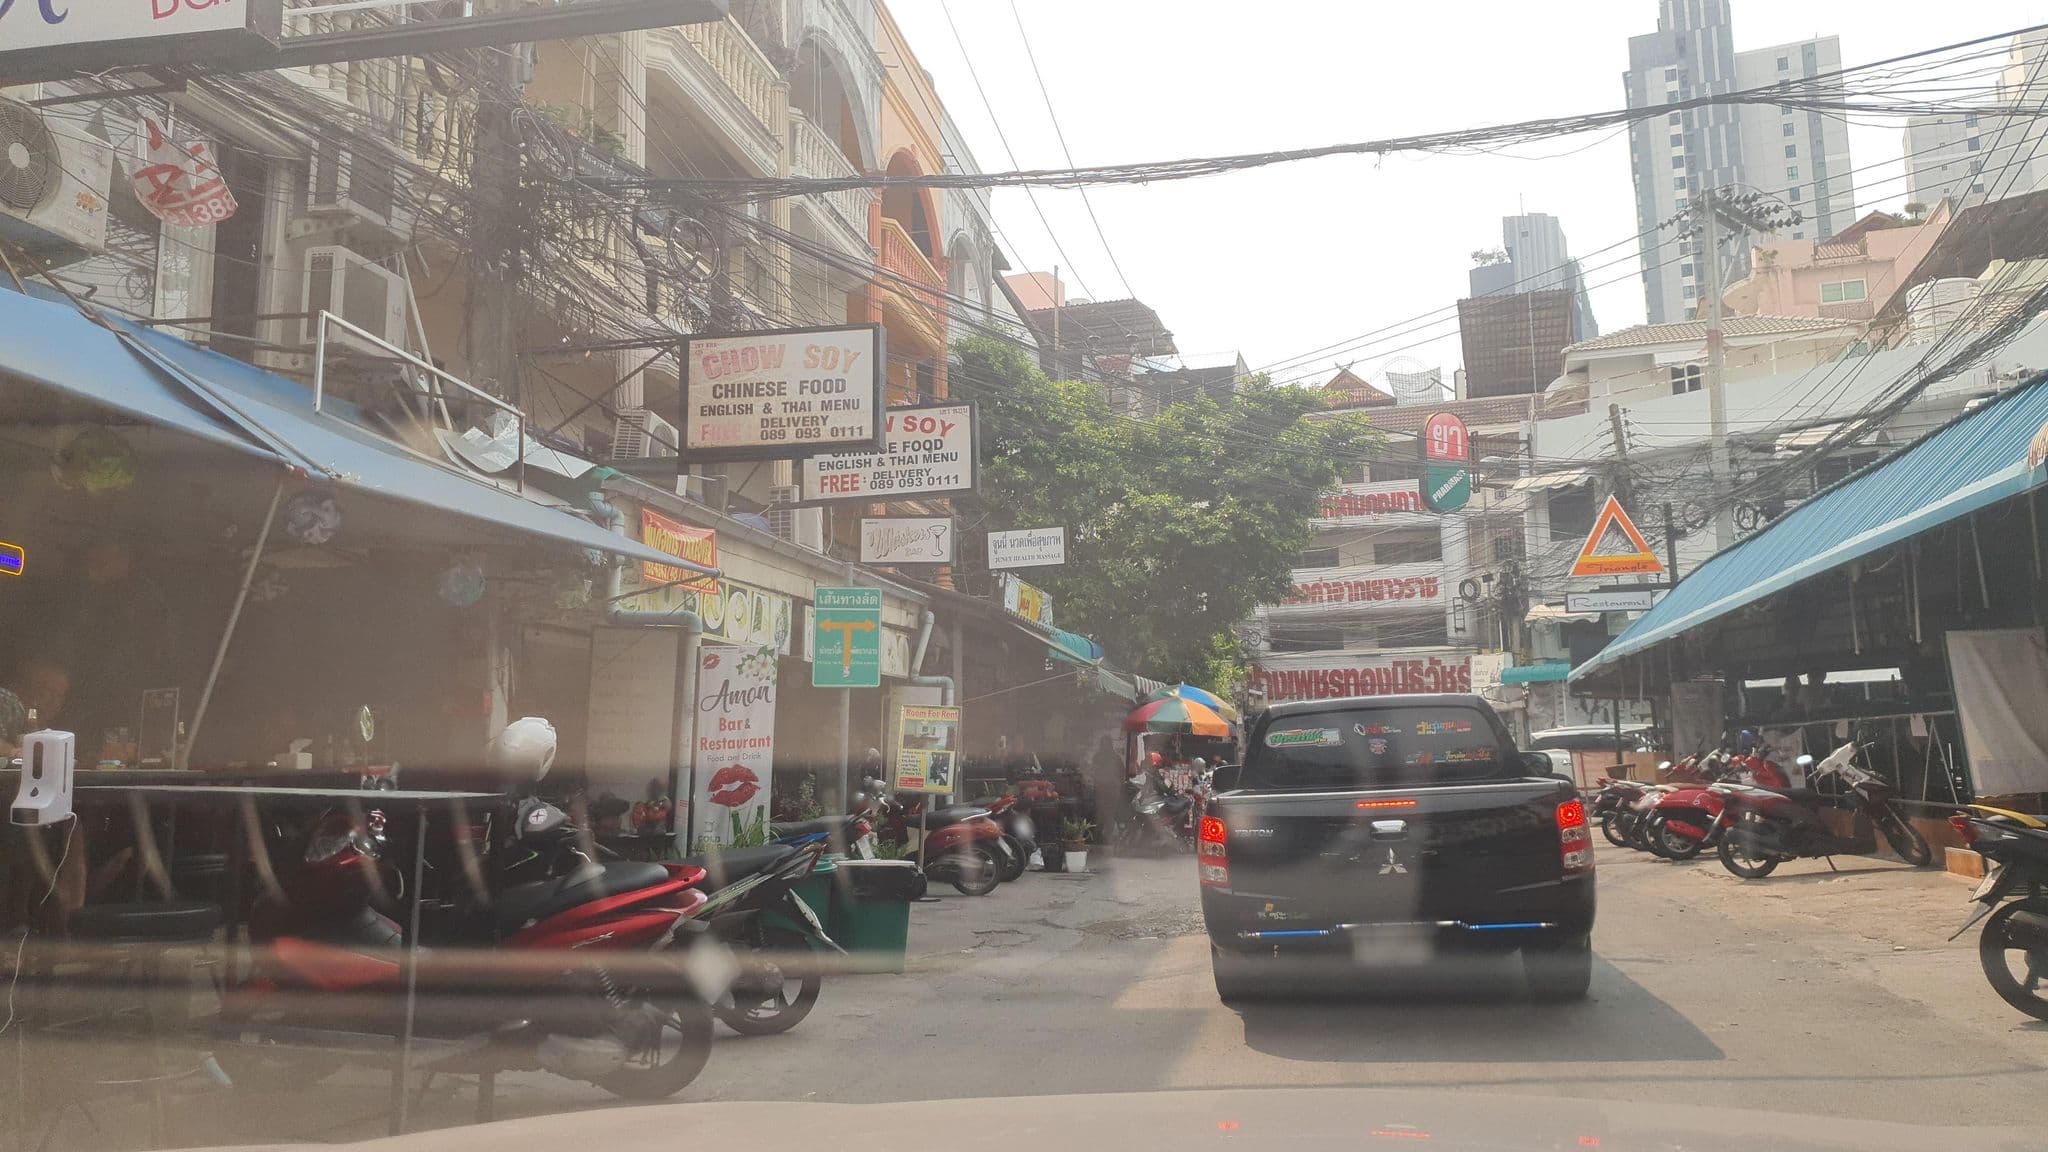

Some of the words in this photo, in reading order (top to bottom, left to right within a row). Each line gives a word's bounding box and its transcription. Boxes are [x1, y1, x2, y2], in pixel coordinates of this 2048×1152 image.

[701, 344, 786, 379] CHOW
[803, 344, 862, 373] SOY
[712, 381, 787, 399] CHINESE
[799, 378, 847, 394] FOOD
[700, 403, 753, 416] ENGLISH
[762, 402, 773, 414] &
[782, 401, 811, 413] THAI
[821, 398, 860, 411] MENU
[760, 415, 829, 429] DELIVERY
[902, 415, 956, 437] SOY
[760, 429, 786, 440] 089
[795, 427, 821, 439] 093
[830, 425, 864, 438] 0111
[1433, 424, 1462, 456] ยา
[902, 438, 944, 453] FOOD
[819, 459, 872, 472] ENGLISH
[876, 457, 886, 467] &
[889, 454, 919, 466] THAI
[922, 452, 958, 464] MENU
[872, 467, 932, 480] DELIVERY
[820, 473, 860, 494] FREE
[869, 479, 894, 490] 089
[898, 477, 923, 488] 093
[927, 474, 959, 487] 0111
[1586, 562, 1648, 572] Triangle
[819, 591, 878, 605] เส้นทางลัด
[701, 679, 772, 713] Amon
[906, 708, 926, 718] Room
[928, 709, 939, 718] For
[719, 717, 743, 731] Bar
[744, 718, 751, 730] &
[700, 736, 771, 751] Restaurant
[707, 754, 725, 762] Food
[743, 752, 761, 761] Drink
